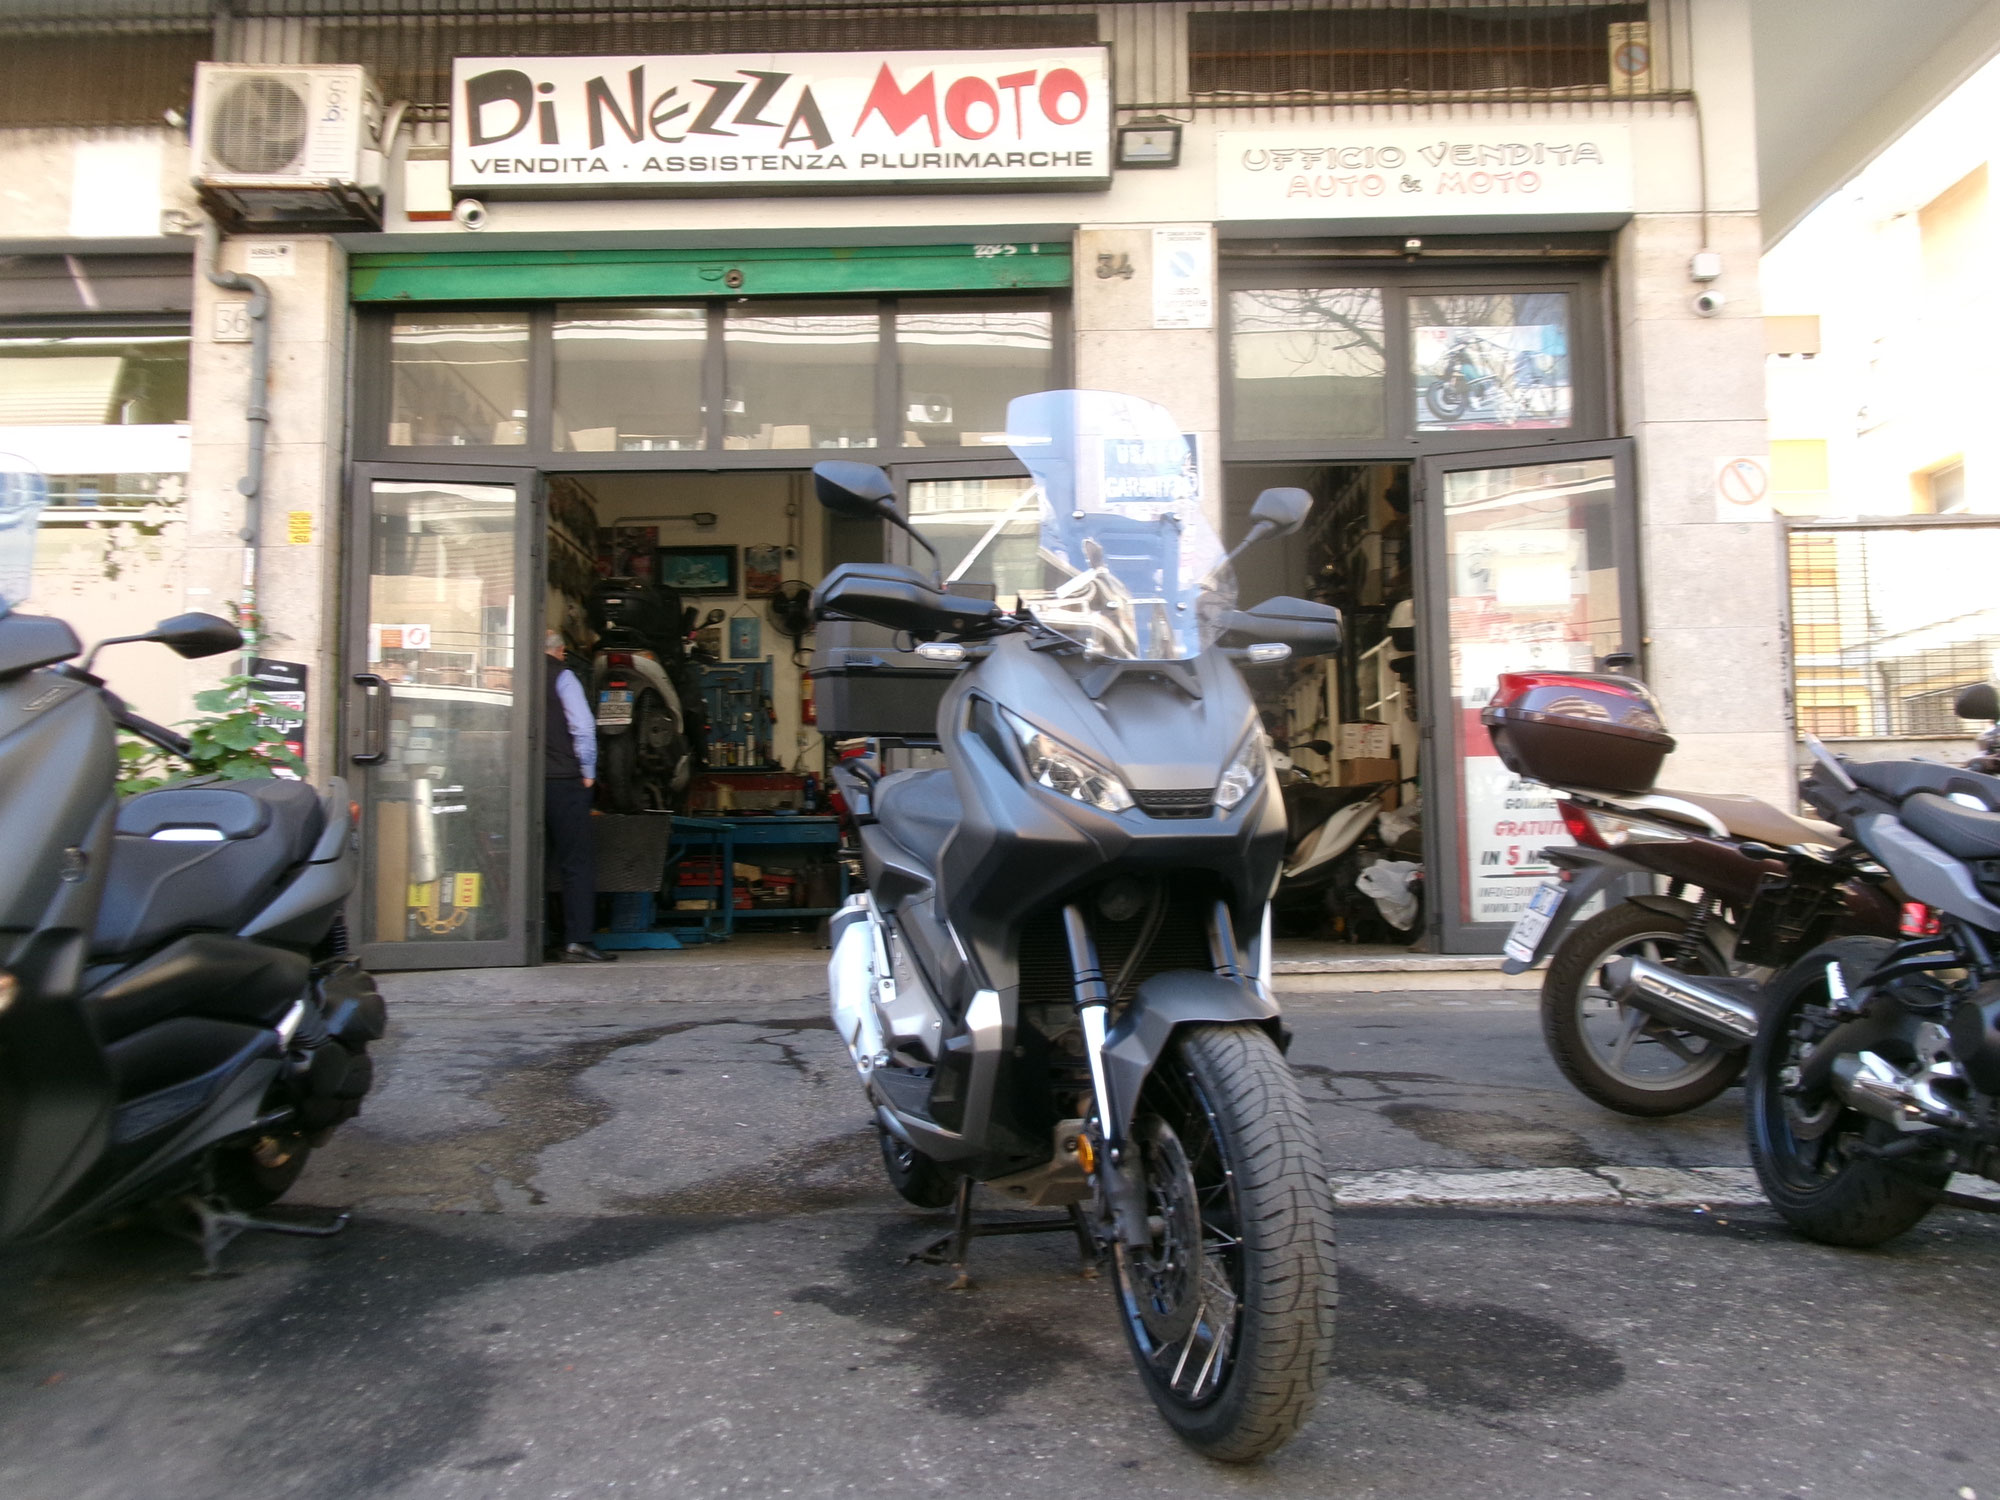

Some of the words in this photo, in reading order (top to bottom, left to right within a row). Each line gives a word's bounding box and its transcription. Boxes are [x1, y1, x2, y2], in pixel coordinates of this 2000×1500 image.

[465, 69, 560, 147] Di
[853, 61, 1088, 147] MOTO
[470, 157, 609, 174] VENDITA
[642, 154, 848, 172] ASSISTENZA
[861, 151, 1093, 170] PLURIMARCHE
[1241, 146, 1406, 171] UFFICIO
[1419, 142, 1604, 168] VENDITA
[1286, 174, 1386, 198] AUTO
[1399, 174, 1423, 194] &
[1436, 171, 1541, 195] MOTO
[1096, 252, 1134, 280] 34
[1494, 820, 1568, 836] GRATUIT
[1505, 845, 1520, 866] 5
